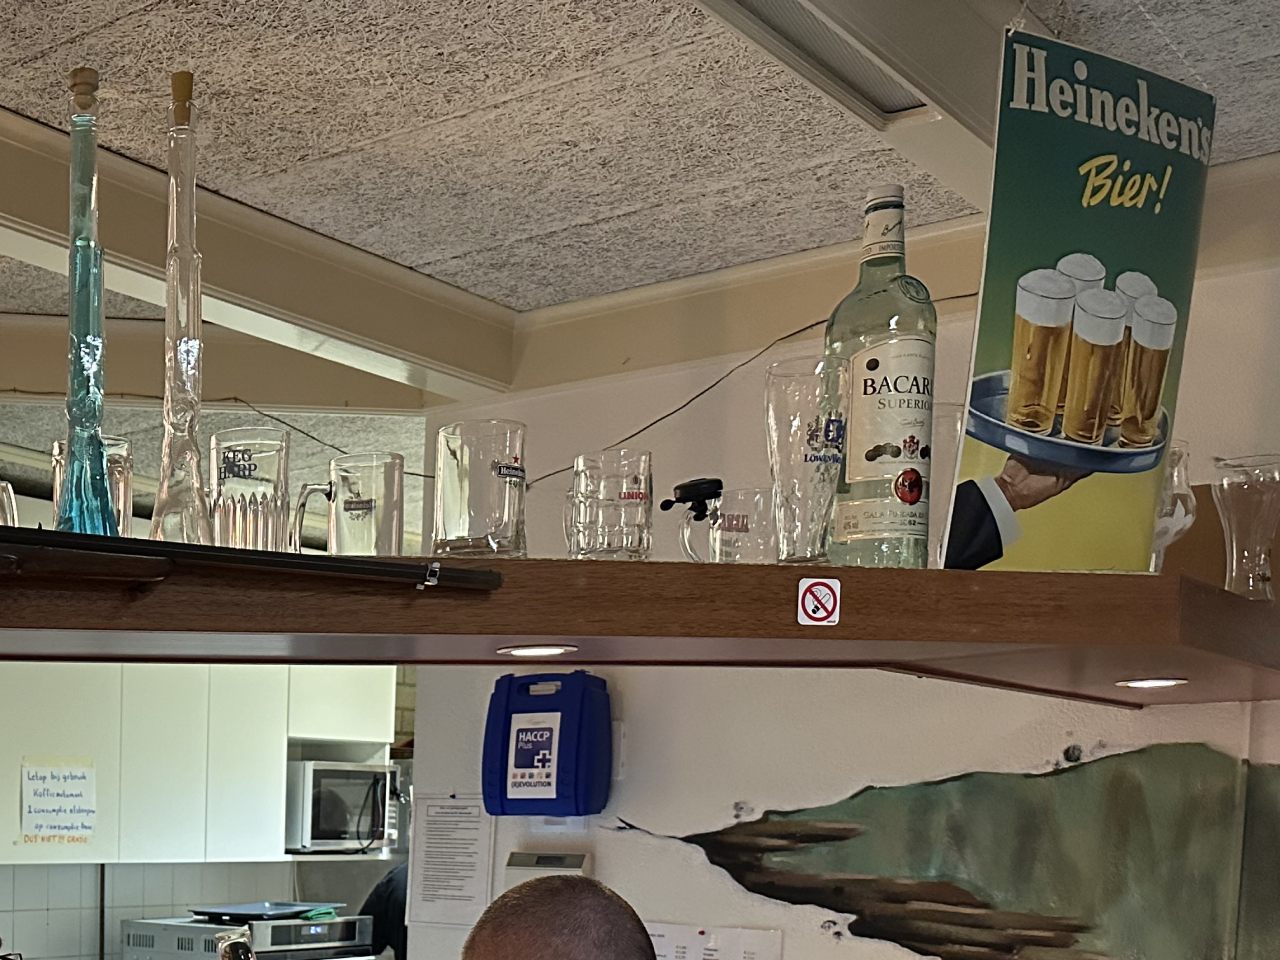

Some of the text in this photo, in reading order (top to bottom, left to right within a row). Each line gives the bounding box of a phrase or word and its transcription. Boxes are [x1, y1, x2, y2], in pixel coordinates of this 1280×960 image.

[1009, 42, 1214, 166] Heineken's
[1078, 154, 1173, 214] Bier!
[862, 375, 933, 396] BACAR
[877, 398, 932, 411] SUPERIO
[221, 449, 252, 465] KEG
[618, 491, 649, 501] UNION
[519, 730, 551, 742] HACCP
[517, 741, 533, 750] Plus
